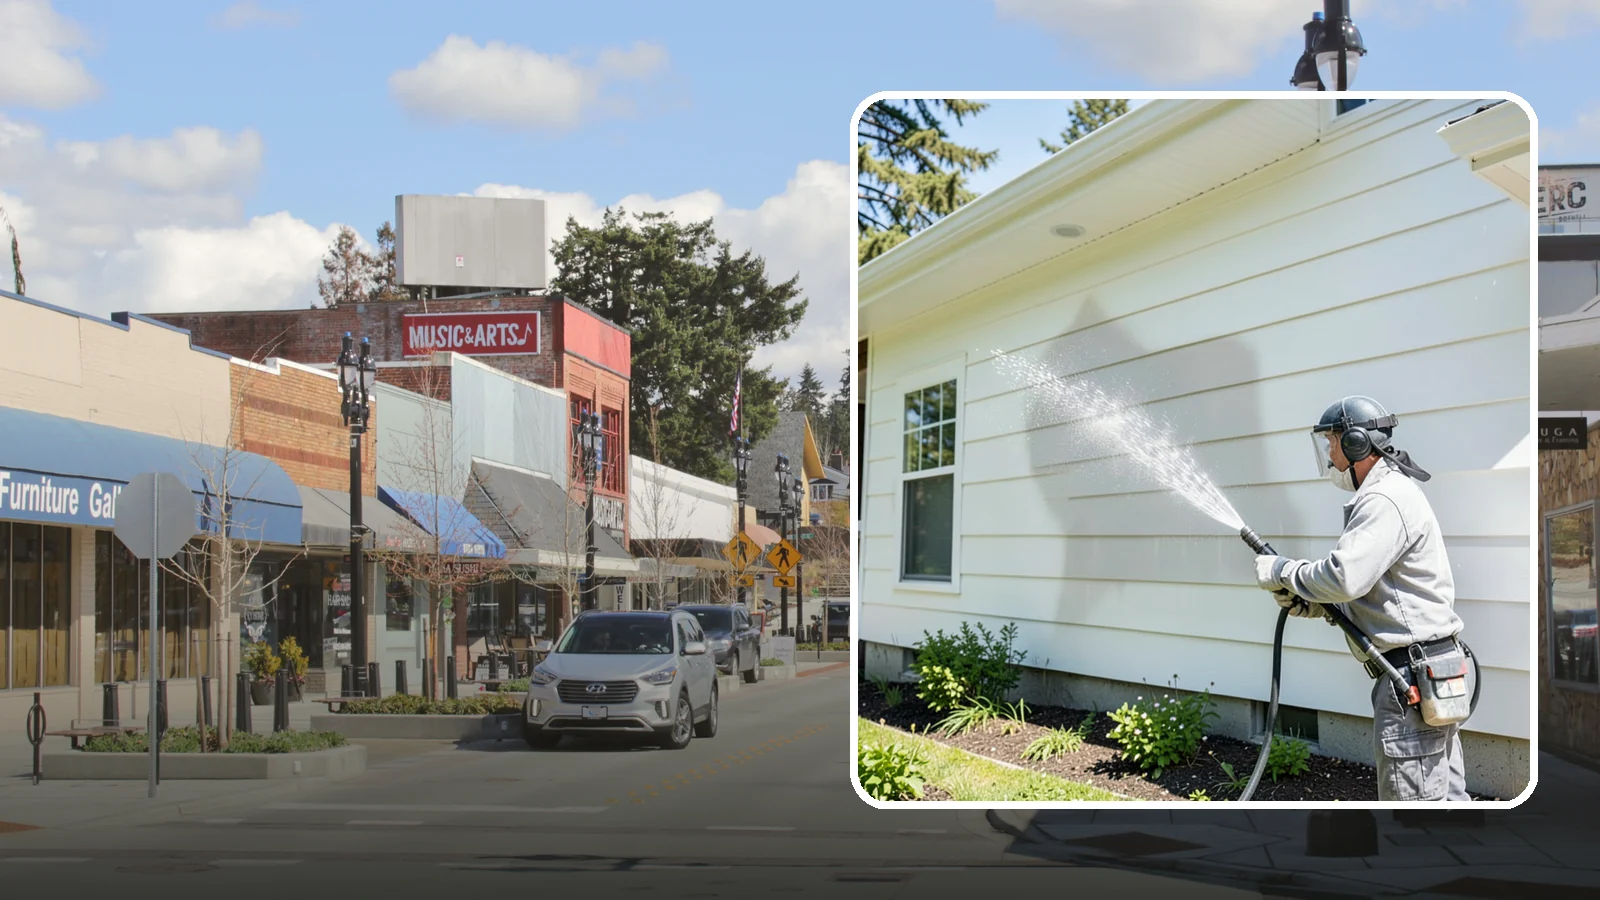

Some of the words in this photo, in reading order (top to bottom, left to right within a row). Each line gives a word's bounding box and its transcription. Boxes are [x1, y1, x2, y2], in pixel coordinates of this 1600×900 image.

[1540, 427, 1578, 436] UGA
[0, 471, 79, 515] Furniture
[453, 564, 479, 573] SUSHI
[340, 594, 352, 607] SALO
